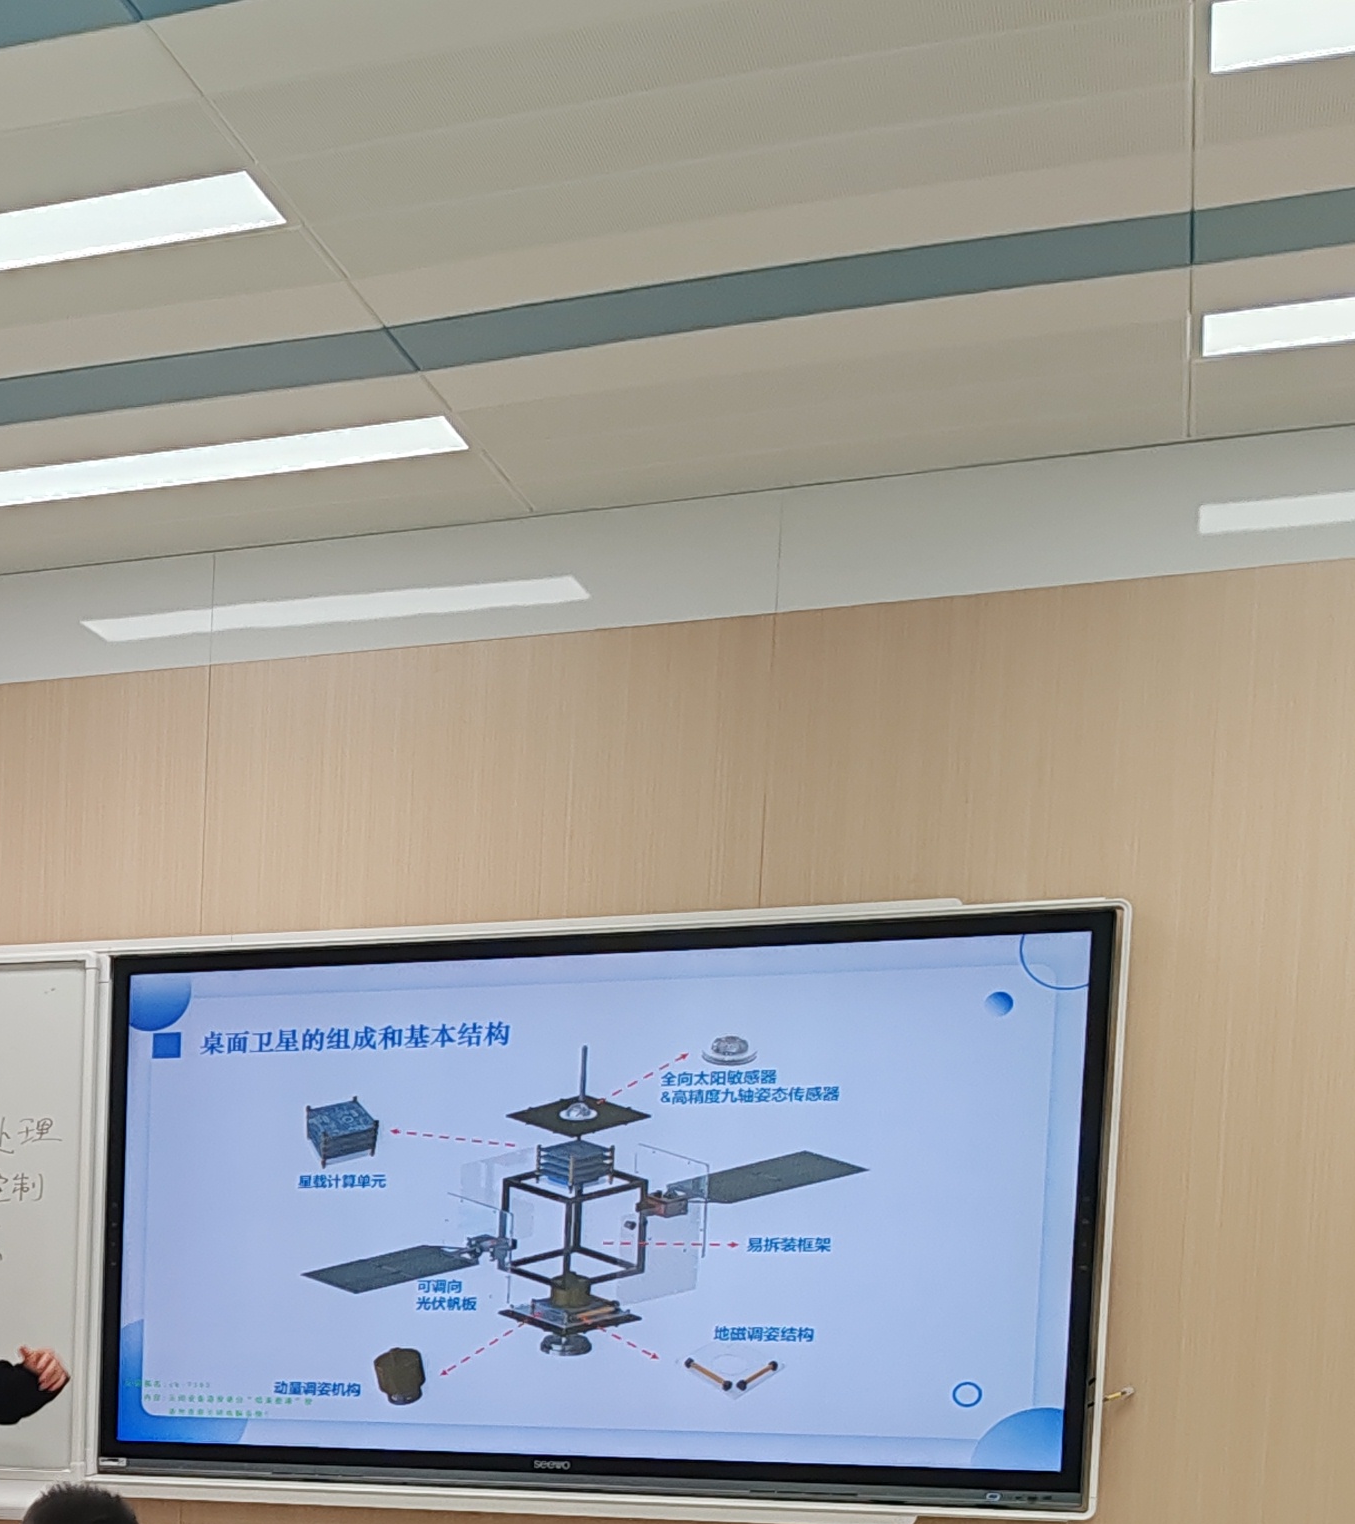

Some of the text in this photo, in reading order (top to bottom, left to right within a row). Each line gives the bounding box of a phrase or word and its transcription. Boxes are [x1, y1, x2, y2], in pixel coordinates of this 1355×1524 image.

[200, 1021, 510, 1056] 桌面卫星的组成和基本结构
[660, 1069, 777, 1087] 全向太阳敏感器
[660, 1086, 840, 1105] &高精度九轴姿态传感器
[297, 1173, 387, 1190] 星载计算单元
[747, 1236, 832, 1253] 易拆装框架
[416, 1279, 463, 1294] 可调向
[416, 1295, 478, 1312] 光伏帆板
[713, 1325, 815, 1343] 地磁调姿结构
[273, 1381, 362, 1398] 动量调姿机构
